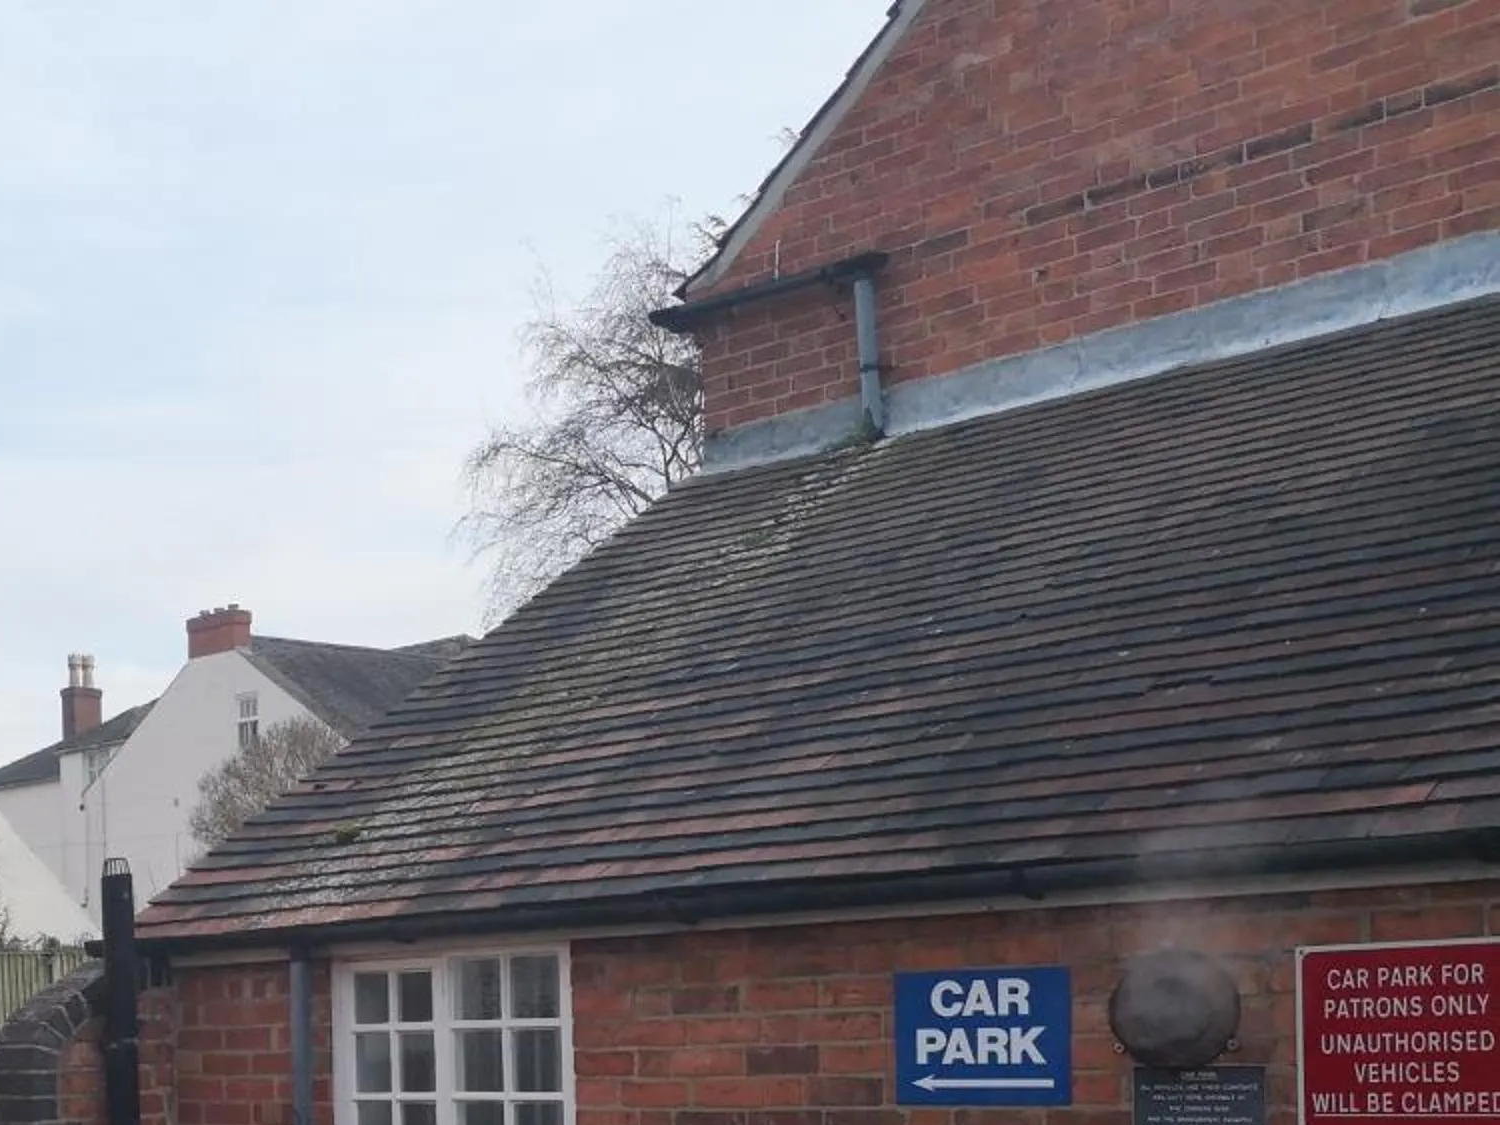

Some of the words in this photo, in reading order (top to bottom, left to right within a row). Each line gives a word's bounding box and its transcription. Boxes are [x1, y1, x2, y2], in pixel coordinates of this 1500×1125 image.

[1327, 968, 1369, 990] CAR
[1377, 964, 1433, 987] PARK
[1441, 963, 1484, 985] FOR
[930, 978, 1030, 1018] CAR
[1324, 995, 1423, 1019] PATRONS
[1431, 993, 1490, 1017] ONLY
[916, 1026, 1047, 1065] PARK
[1321, 1030, 1495, 1054] UNAUTHORISED
[1354, 1061, 1461, 1083] VEHICLES
[1312, 1092, 1360, 1113] WILL
[1367, 1092, 1394, 1113] BE
